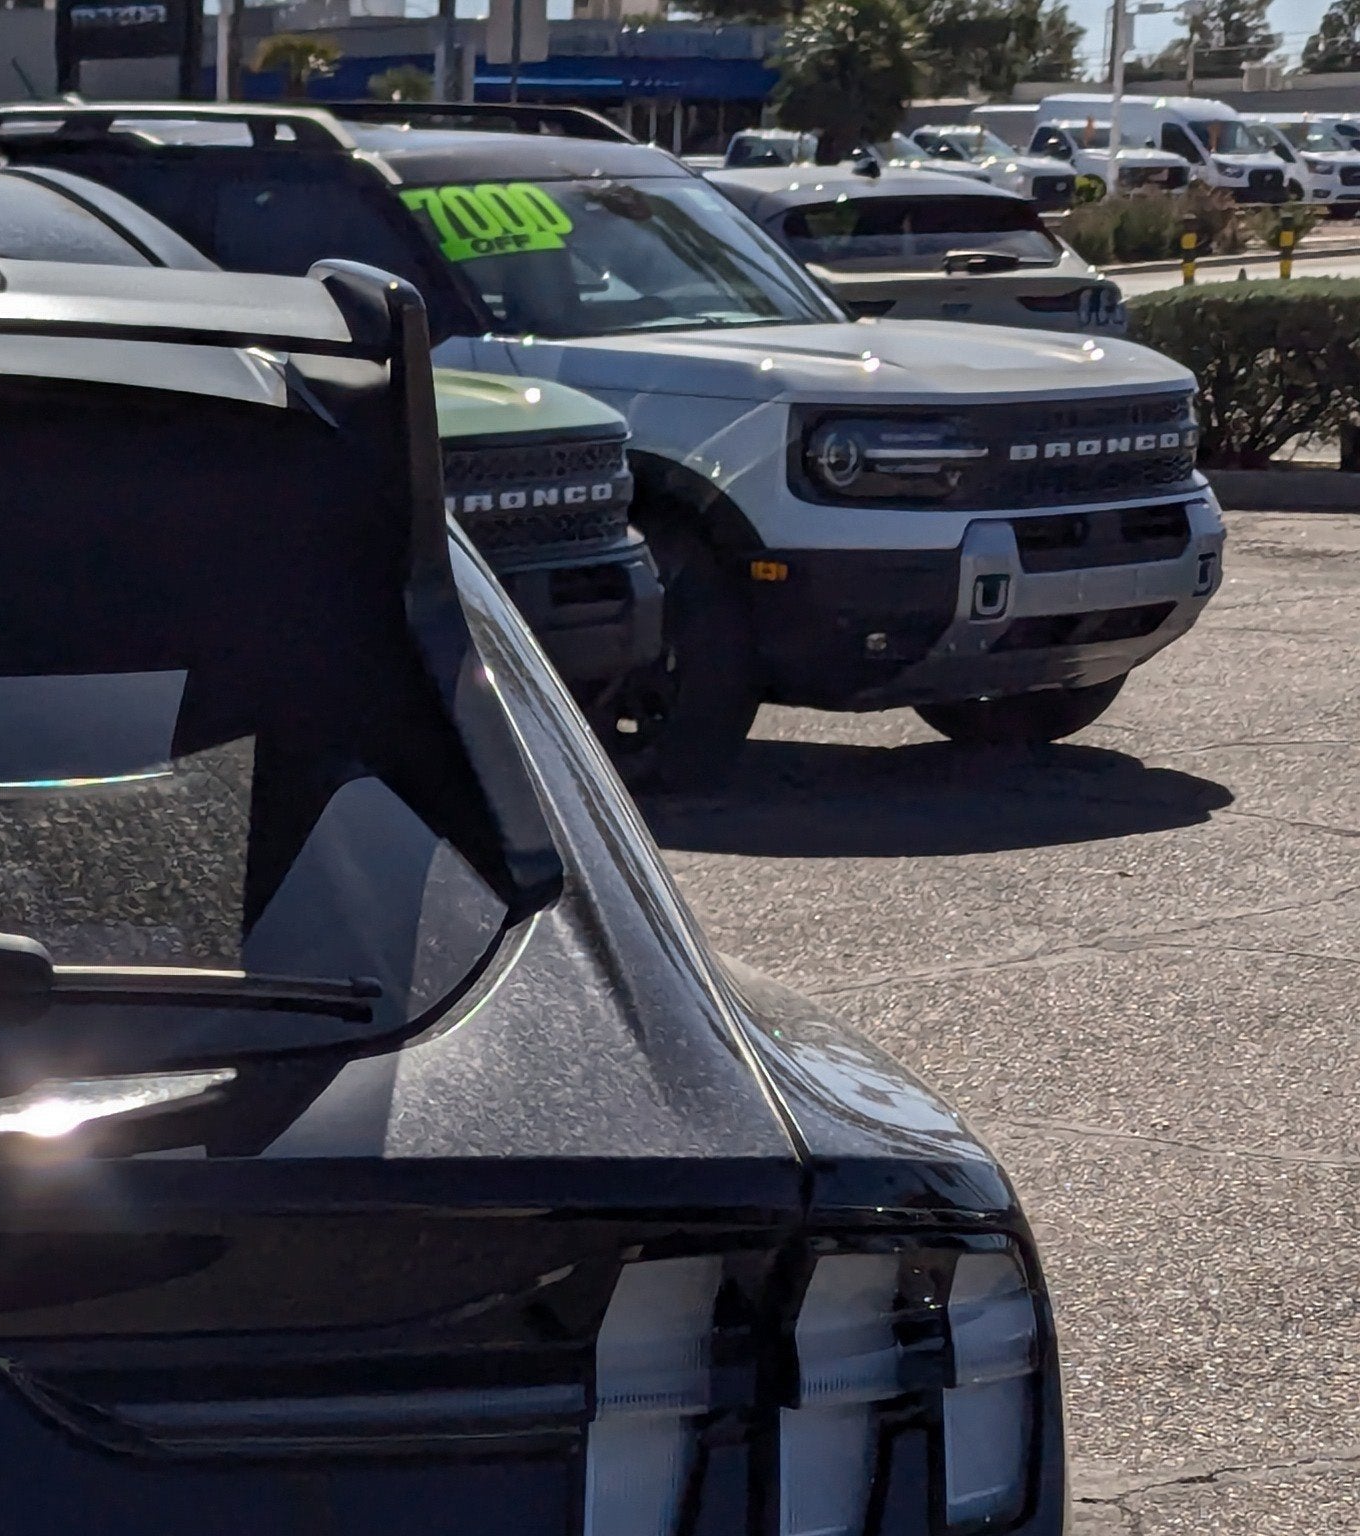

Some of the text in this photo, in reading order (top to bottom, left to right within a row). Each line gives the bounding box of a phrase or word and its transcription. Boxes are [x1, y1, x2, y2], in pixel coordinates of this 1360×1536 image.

[399, 182, 573, 241] 7000
[471, 234, 530, 254] OFF
[1009, 432, 1180, 461] BRONCO
